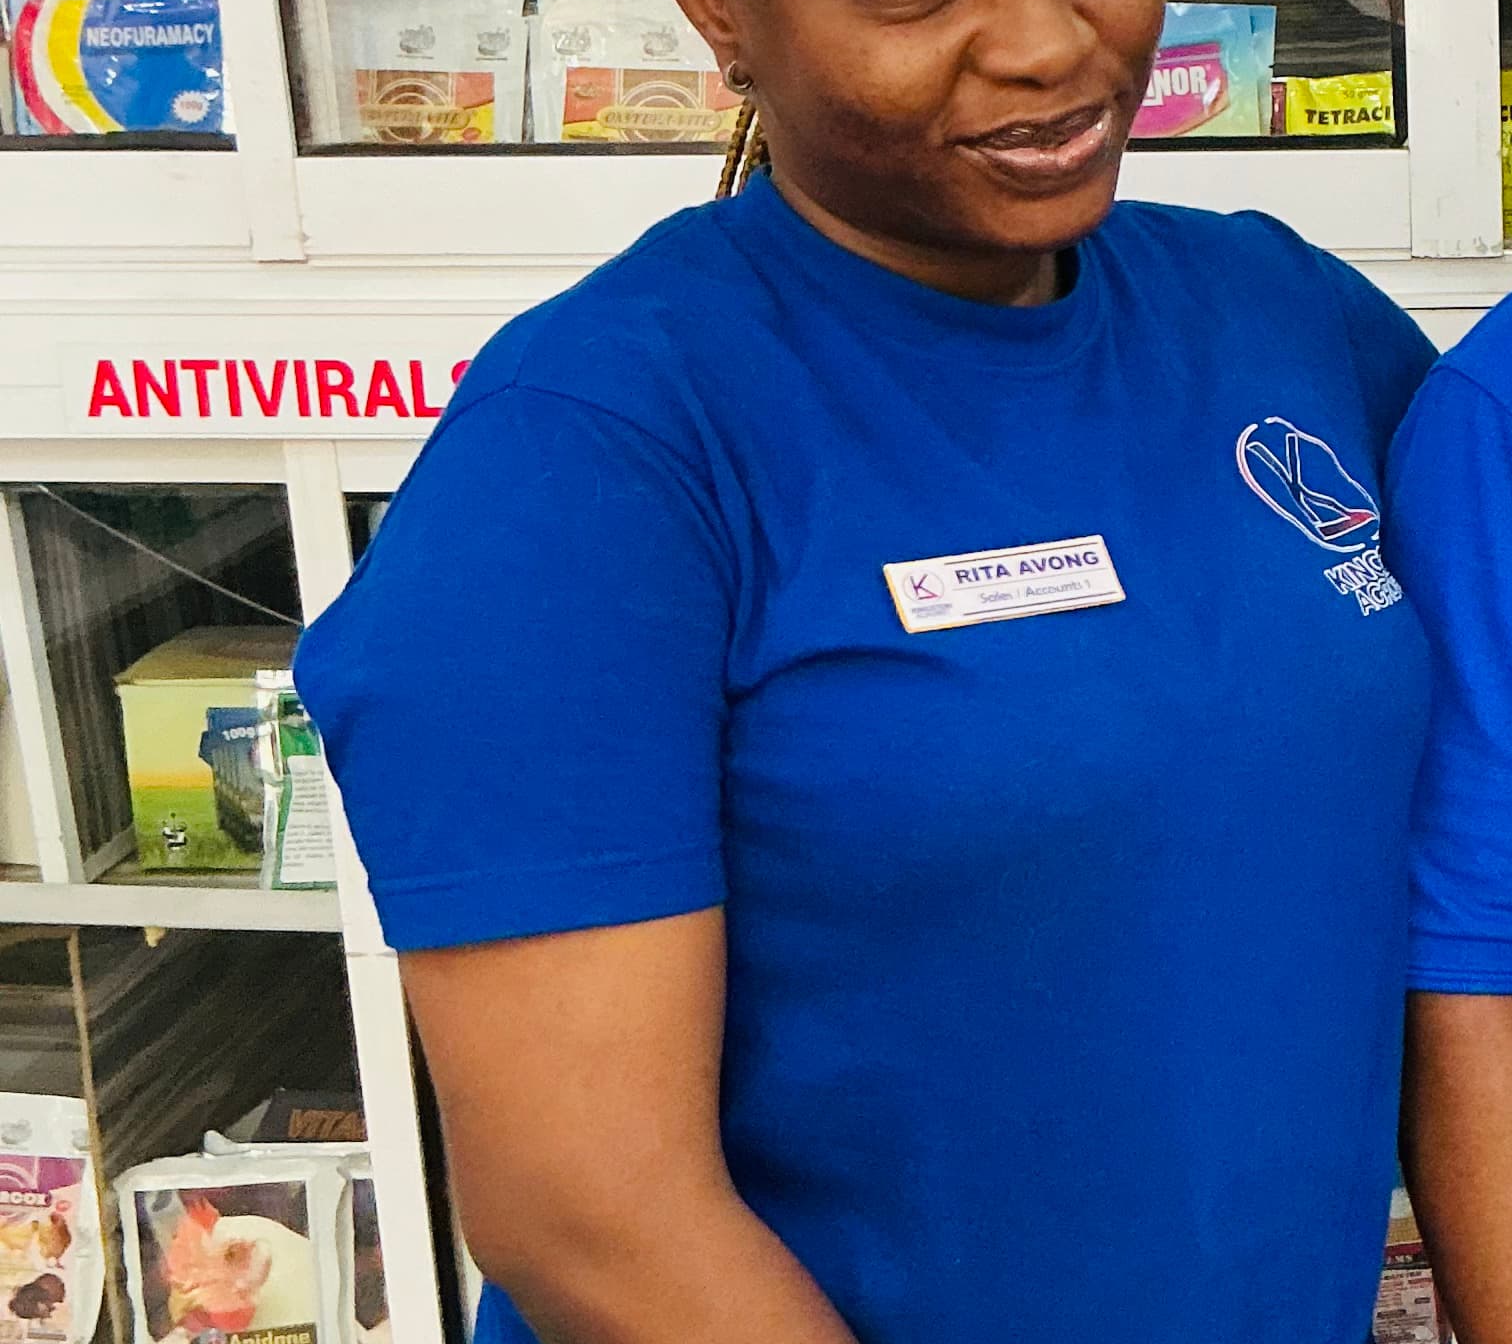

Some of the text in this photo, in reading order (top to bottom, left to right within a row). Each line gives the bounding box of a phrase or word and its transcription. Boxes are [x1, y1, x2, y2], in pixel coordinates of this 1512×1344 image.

[87, 24, 215, 47] NEOFURAMACY
[88, 359, 473, 418] ANTIVIRAL
[955, 551, 1100, 584] RITA AVONG
[1025, 581, 1082, 597] Accounts
